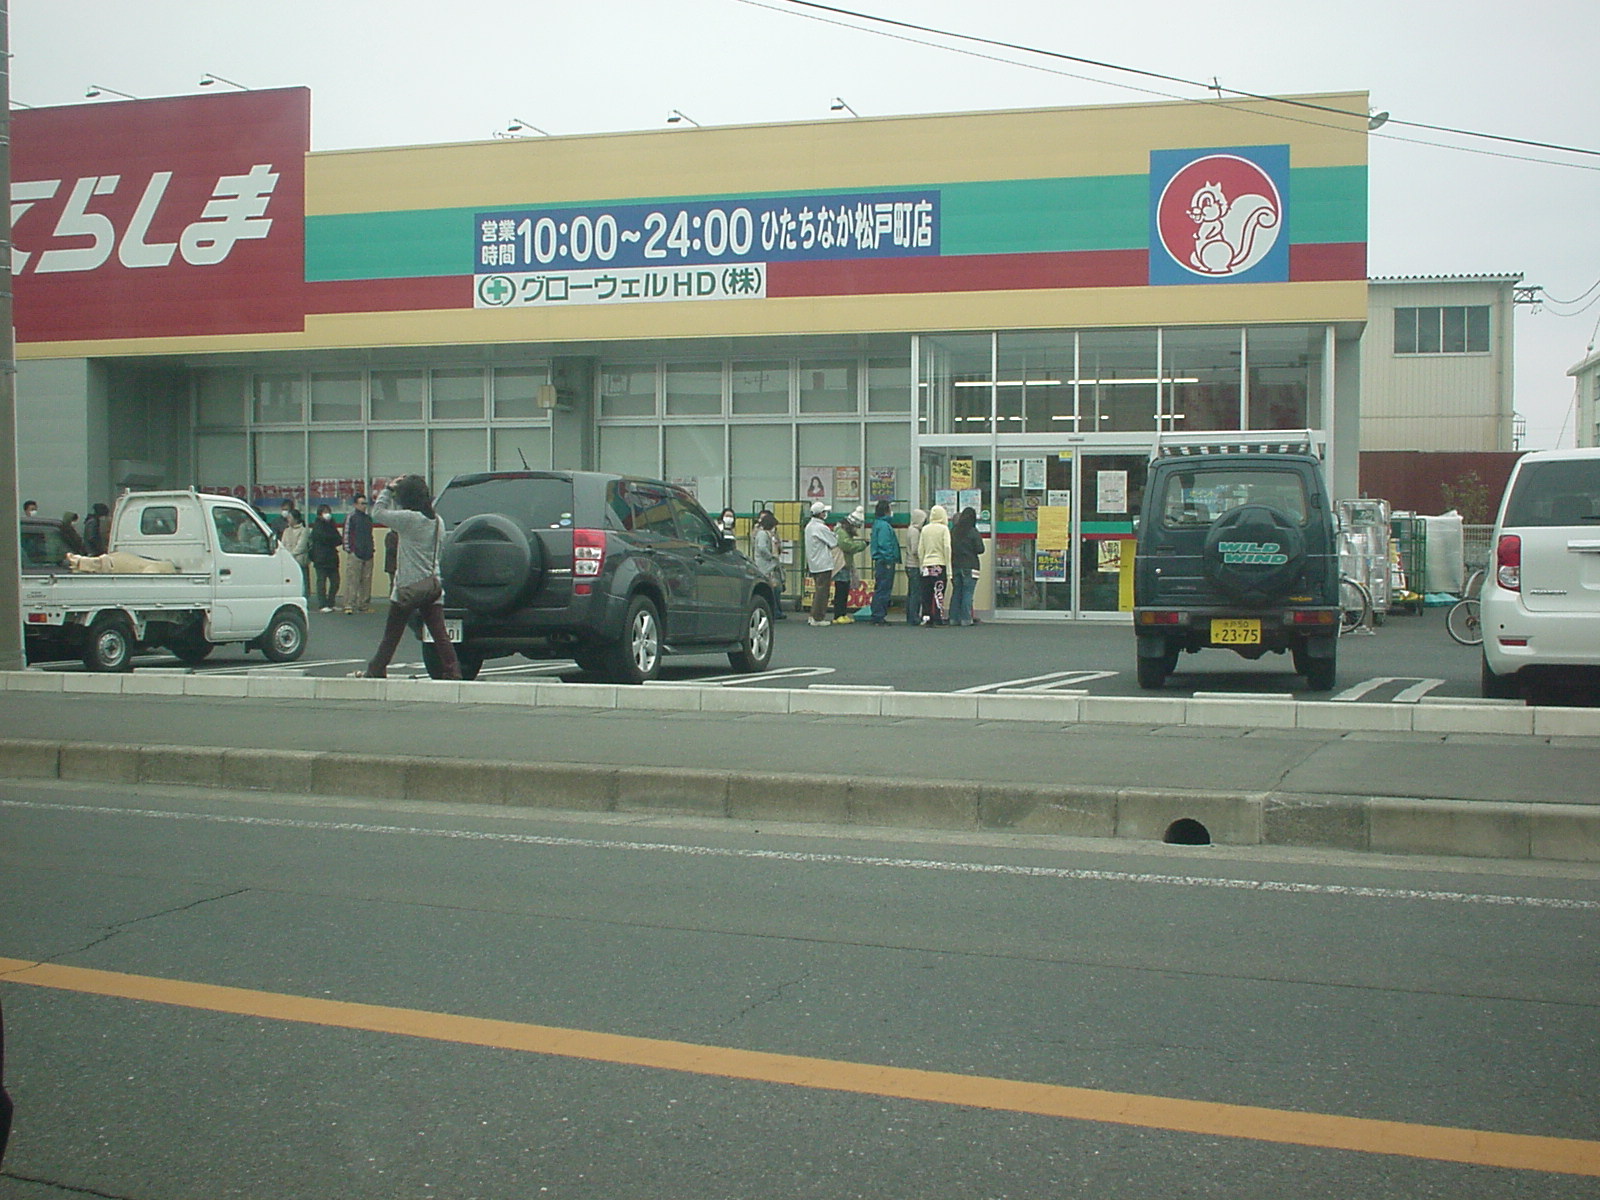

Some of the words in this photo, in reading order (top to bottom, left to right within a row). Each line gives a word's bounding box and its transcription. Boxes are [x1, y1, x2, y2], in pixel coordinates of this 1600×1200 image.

[481, 219, 515, 242] 営業
[761, 199, 933, 251] ひたちなか松戸町店
[481, 243, 516, 266] 時間
[521, 267, 762, 303] グローウェルHD(株)
[1219, 542, 1280, 553] WILD
[1224, 553, 1288, 564] WIND
